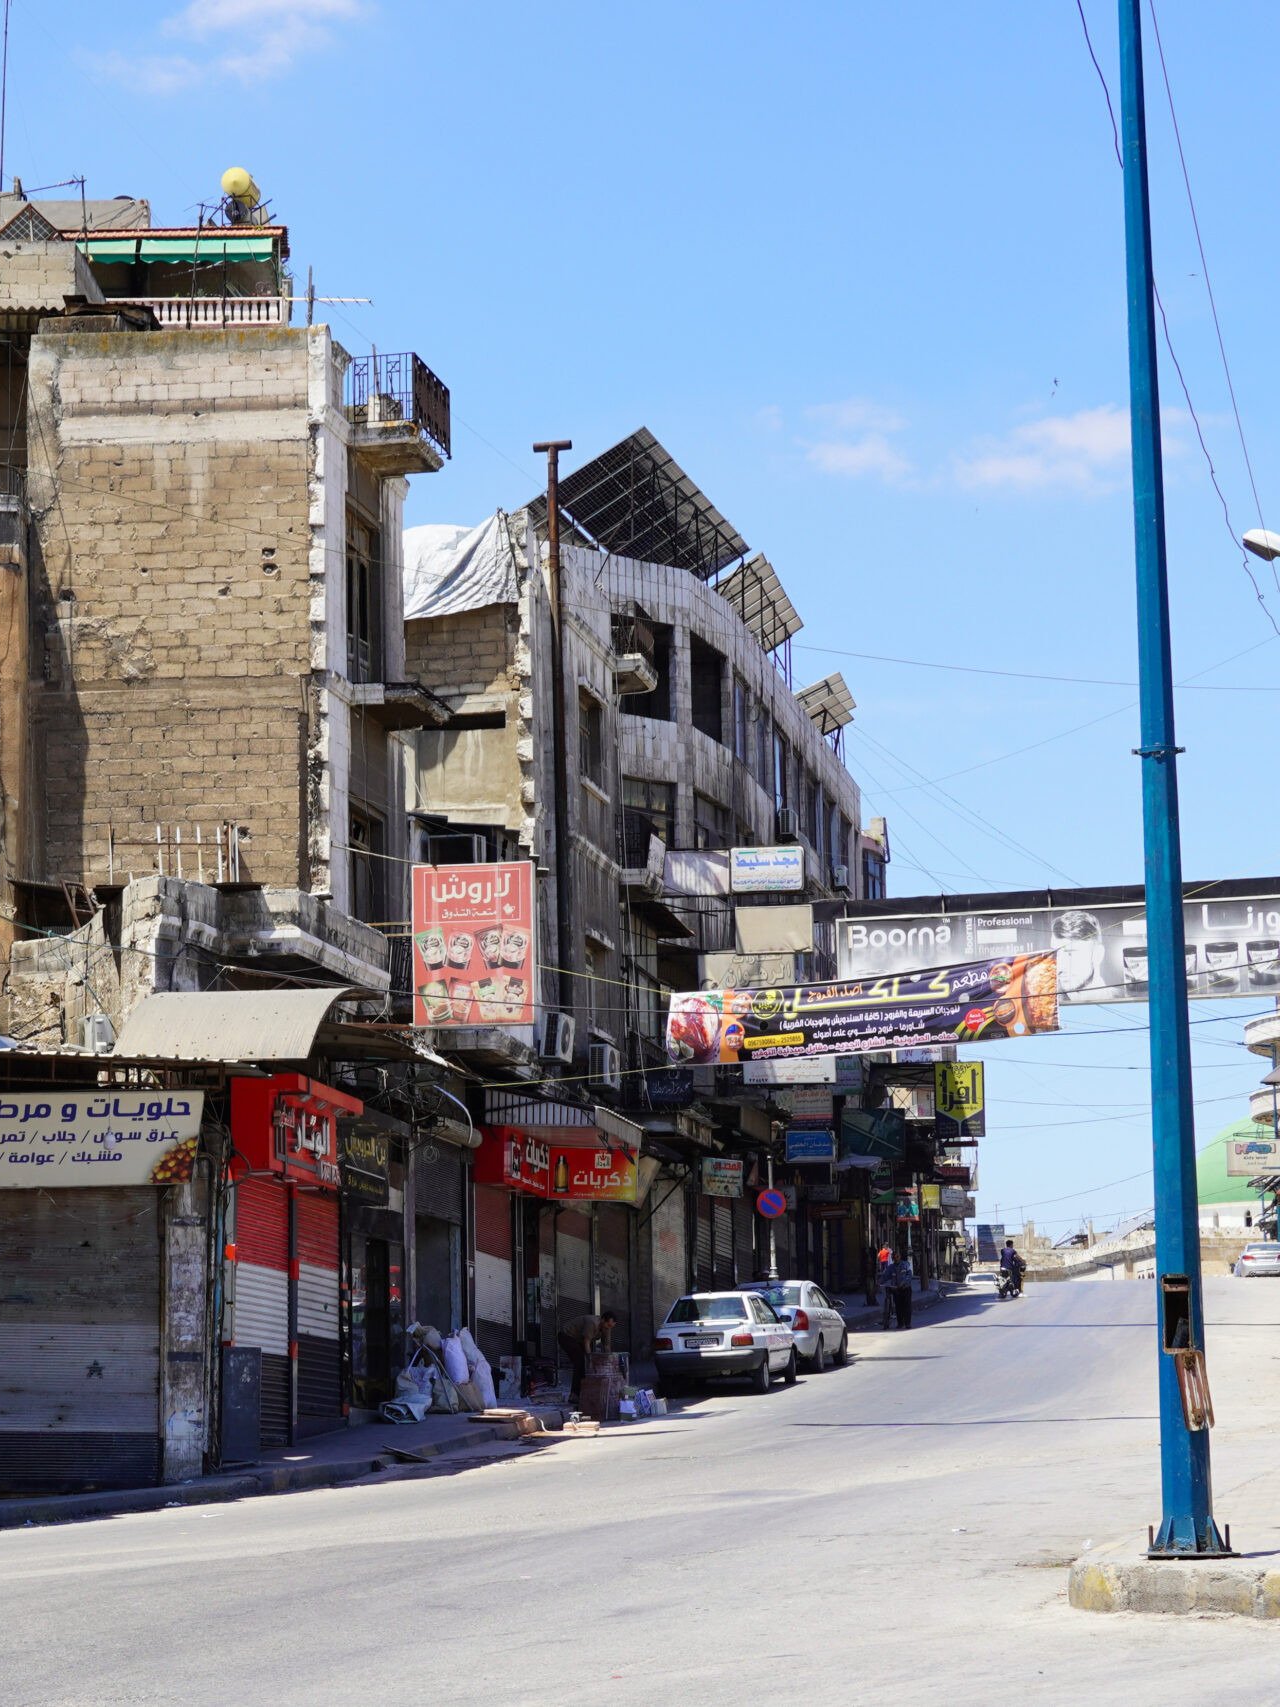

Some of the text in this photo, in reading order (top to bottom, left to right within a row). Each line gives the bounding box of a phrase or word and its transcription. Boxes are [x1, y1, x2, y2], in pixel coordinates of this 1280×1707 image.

[431, 872, 511, 904] لاروش
[977, 915, 1033, 927] Professional
[851, 925, 951, 949] Boorna
[965, 917, 973, 954] Boorna
[1006, 942, 1025, 954] tips
[951, 971, 988, 993] مطعم
[807, 987, 838, 1003] الفروج
[884, 1009, 908, 1021] والفروج
[908, 1007, 934, 1019] السريعة
[935, 1005, 960, 1016] للوجبات
[831, 1014, 863, 1026] السندويش
[878, 1024, 893, 1034] فروج
[861, 1037, 886, 1049] الشارع
[61, 1102, 77, 1123] و
[86, 1097, 191, 1122] حلويات
[0, 1131, 26, 1145] تمر
[42, 1130, 76, 1144] جلاب
[146, 1129, 179, 1143] عرق
[8, 1150, 55, 1165] عوامة
[72, 1149, 122, 1163] مشبك
[573, 1171, 633, 1189] ذكريات
